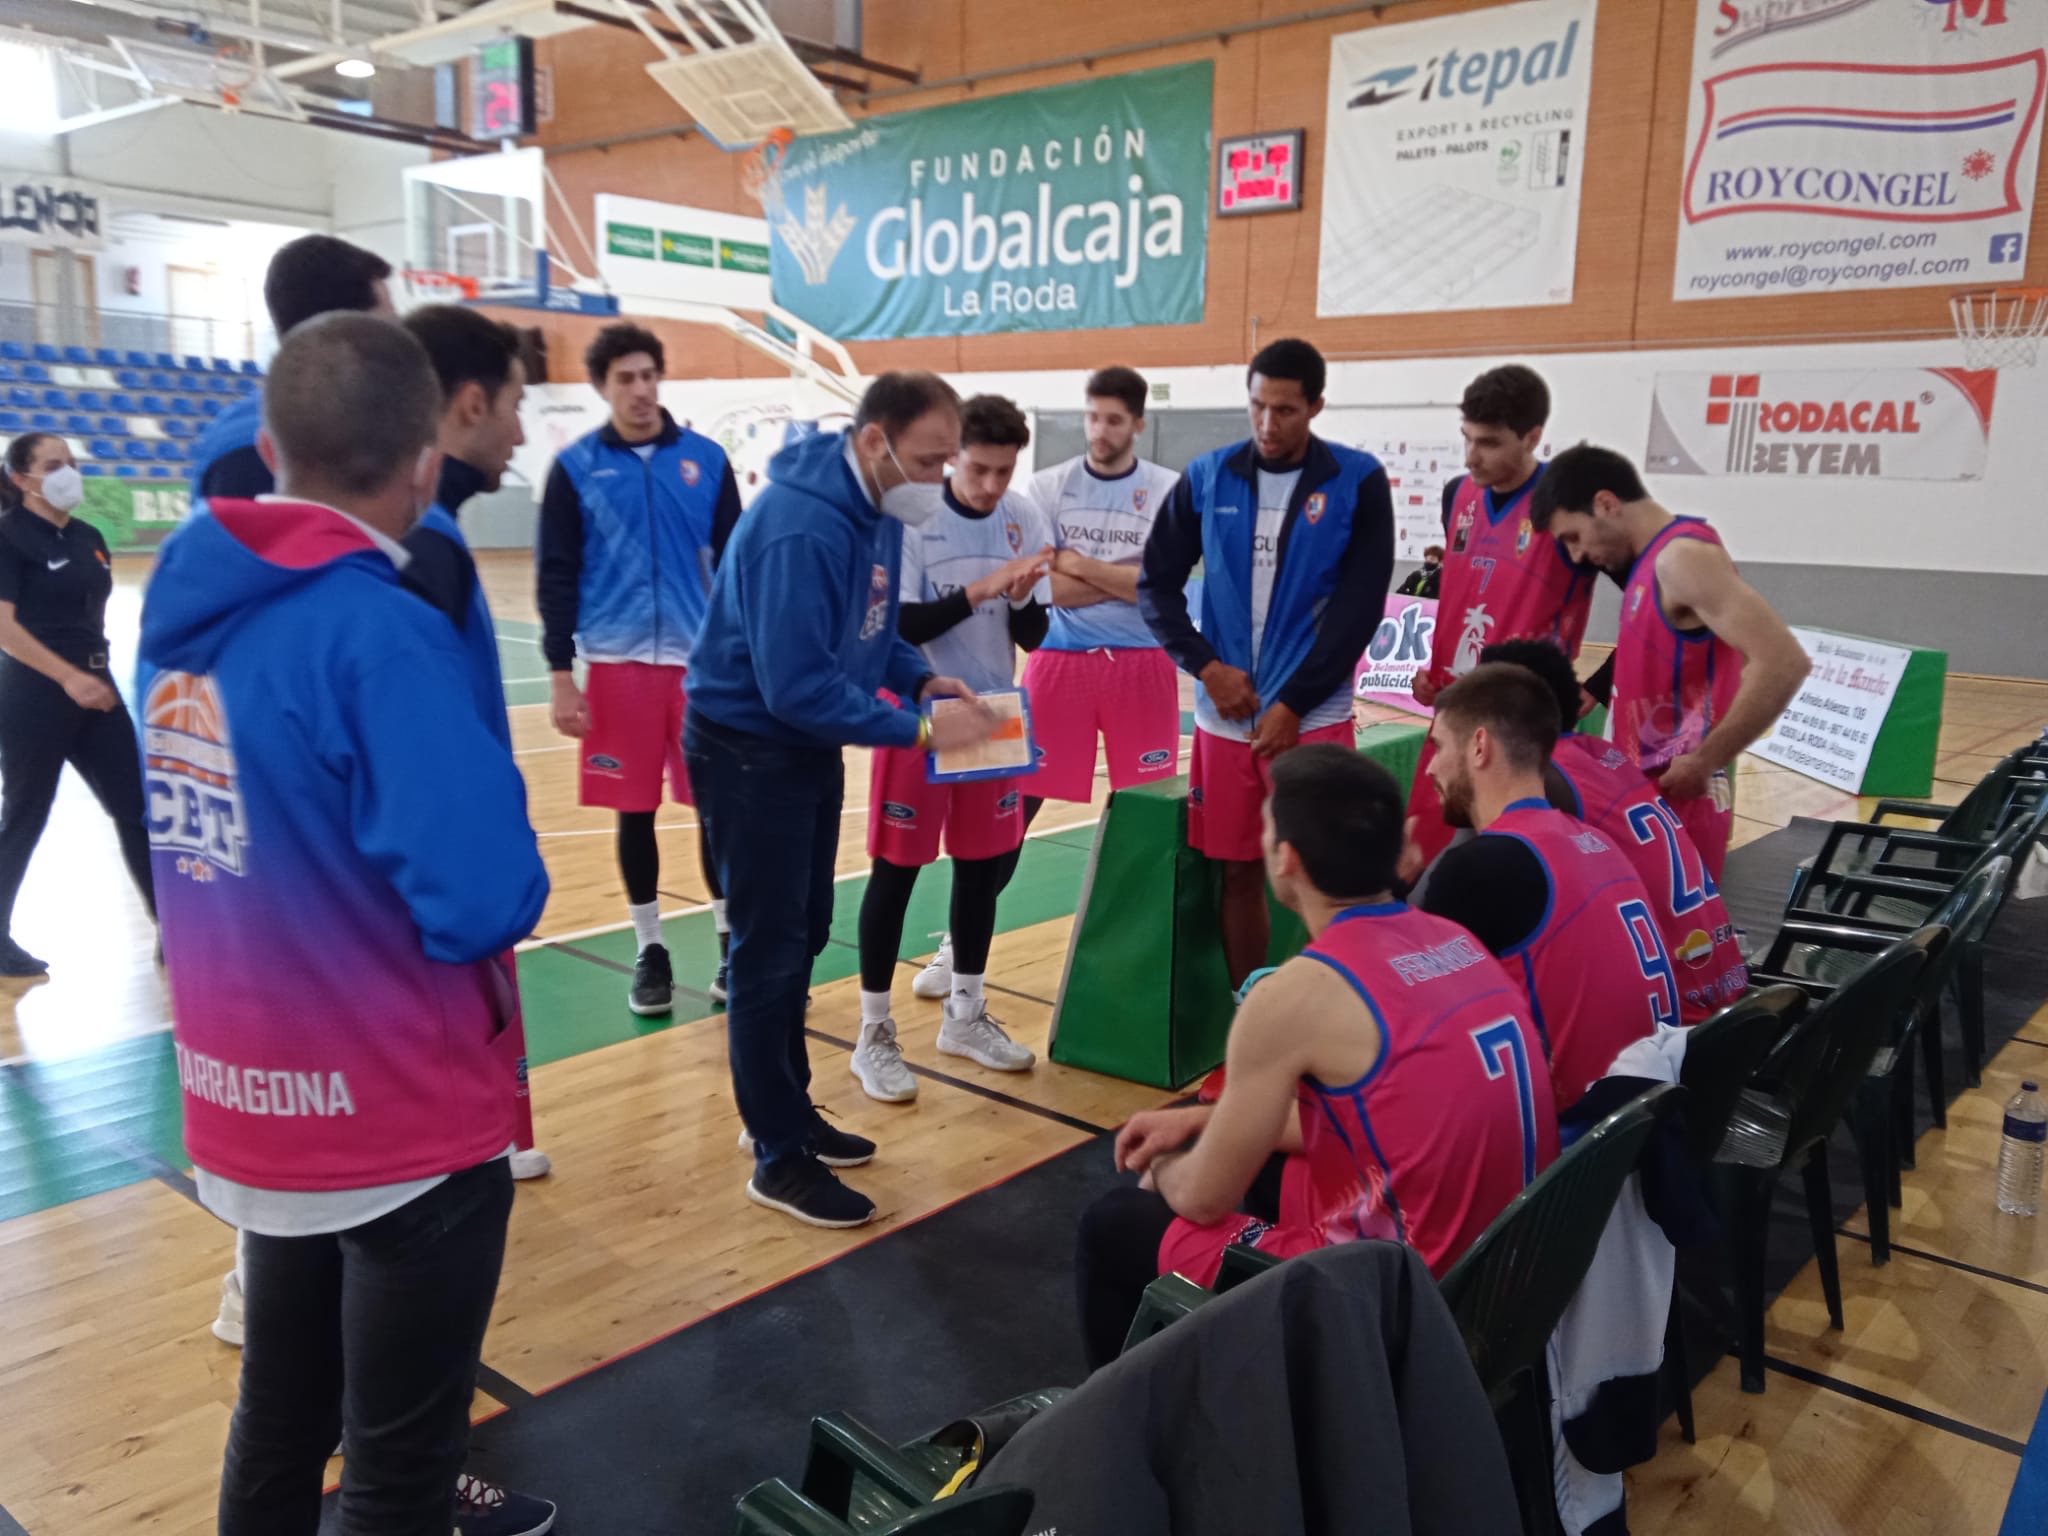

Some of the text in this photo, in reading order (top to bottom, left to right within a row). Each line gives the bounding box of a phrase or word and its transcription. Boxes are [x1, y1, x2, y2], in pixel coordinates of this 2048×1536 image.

[1396, 123, 1458, 141] EXPORT
[1480, 109, 1575, 131] RECYCLING
[911, 125, 1145, 187] FUNDACIÓN
[1396, 146, 1437, 160] PALETS
[1706, 166, 1958, 208] ROYCONGEL
[866, 174, 1183, 289] Globalcaja
[1725, 231, 1938, 262] www.roycongel.com
[1689, 257, 1971, 292] roycongel@roycongel.com
[944, 279, 1077, 316] La Roda
[1617, 898, 1681, 1031] 9
[1468, 1015, 1537, 1190] 7
